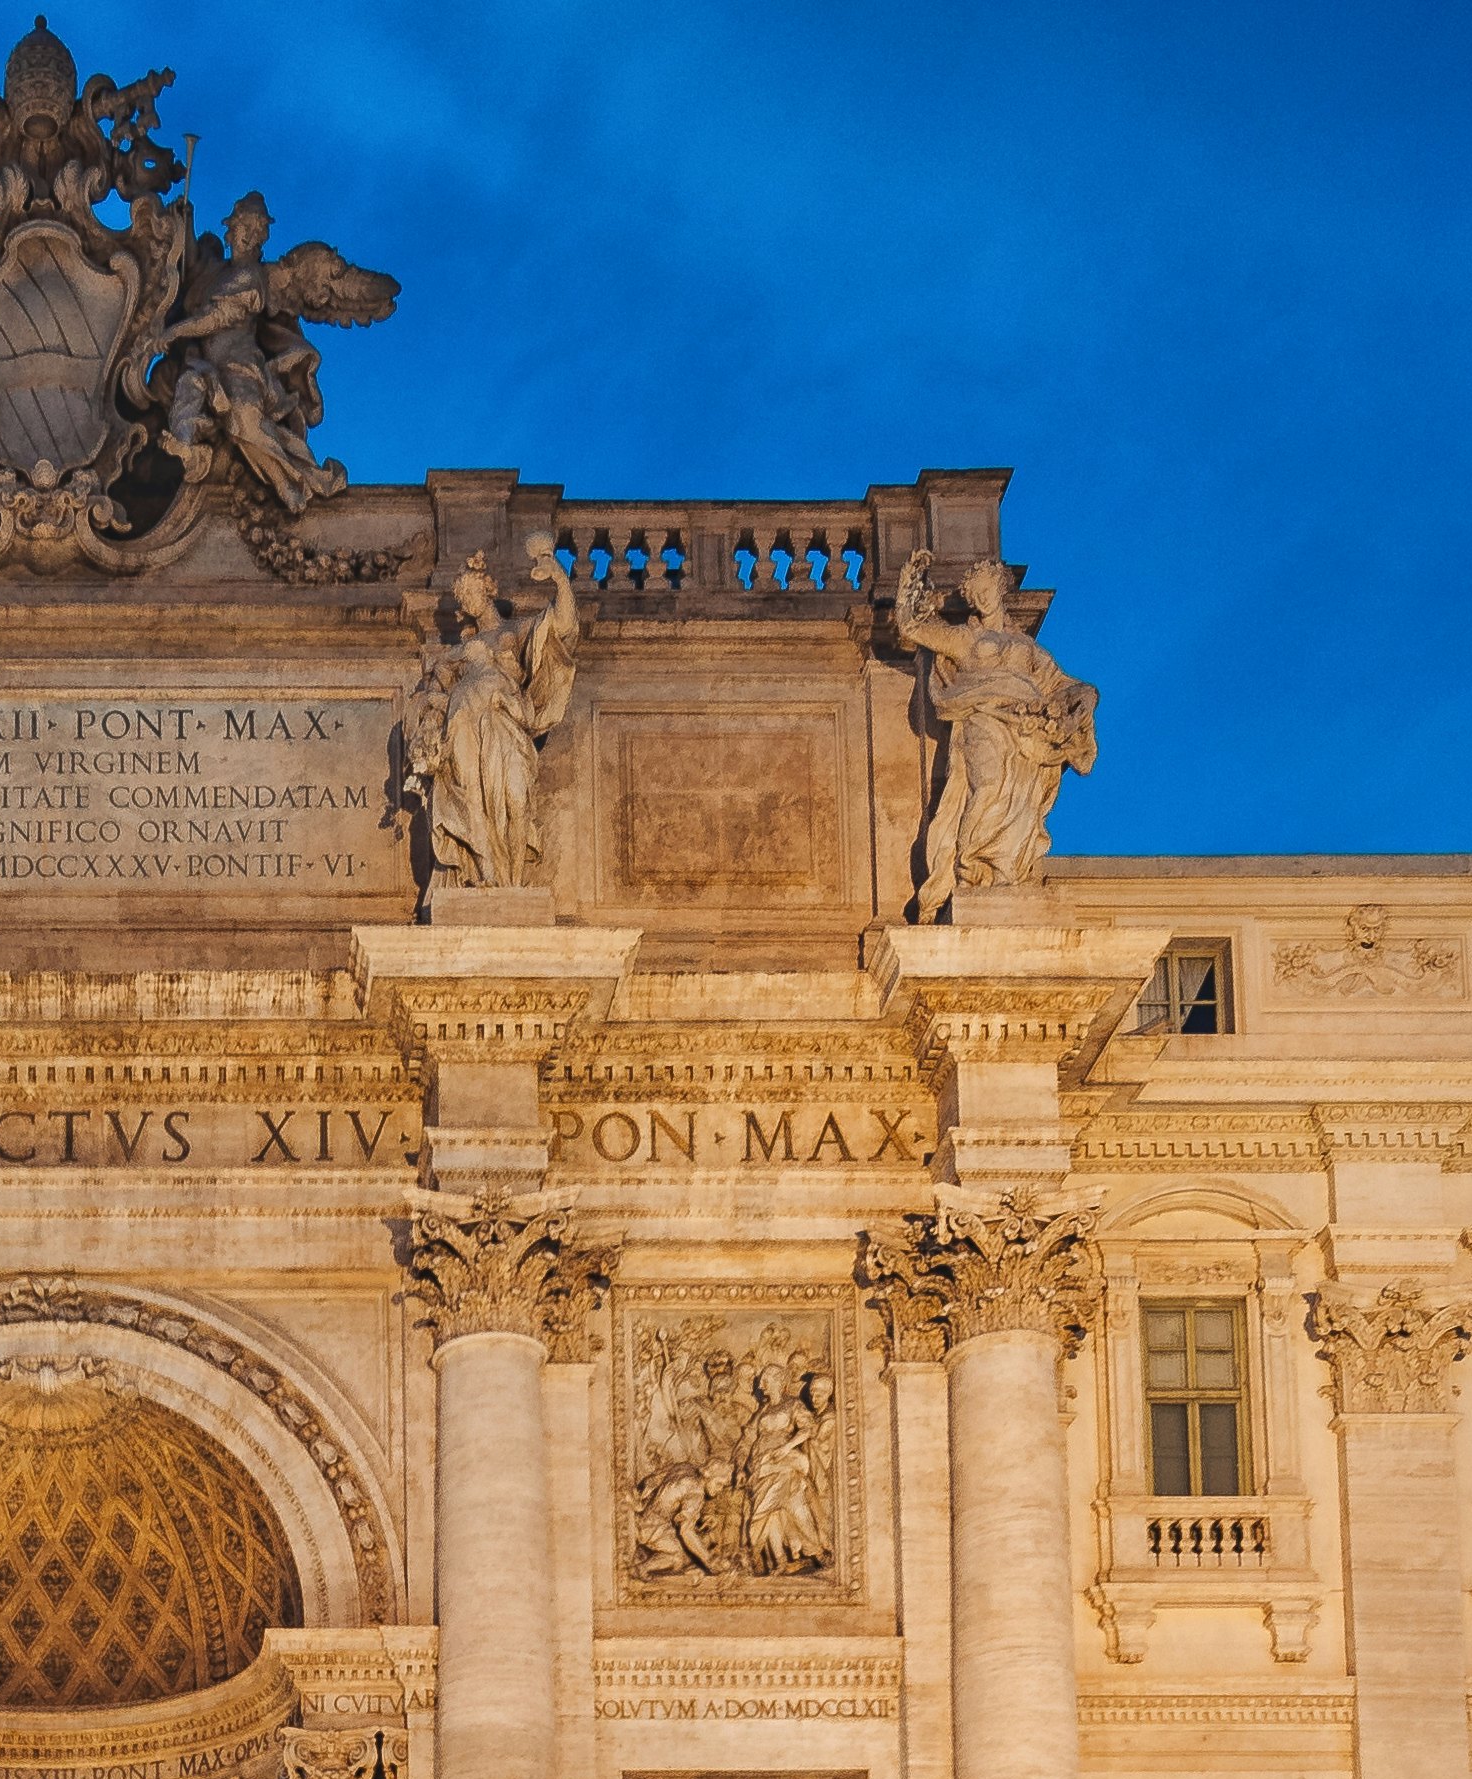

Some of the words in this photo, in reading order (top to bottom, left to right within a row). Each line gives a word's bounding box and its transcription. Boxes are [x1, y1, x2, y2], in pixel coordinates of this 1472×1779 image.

[33, 751, 202, 775] VIRGINEM
[108, 785, 370, 809] COMMENDATAM
[138, 820, 289, 844] ORNAVIT
[594, 1699, 697, 1719] SOLVTVM
[234, 1730, 270, 1764] OPVS
